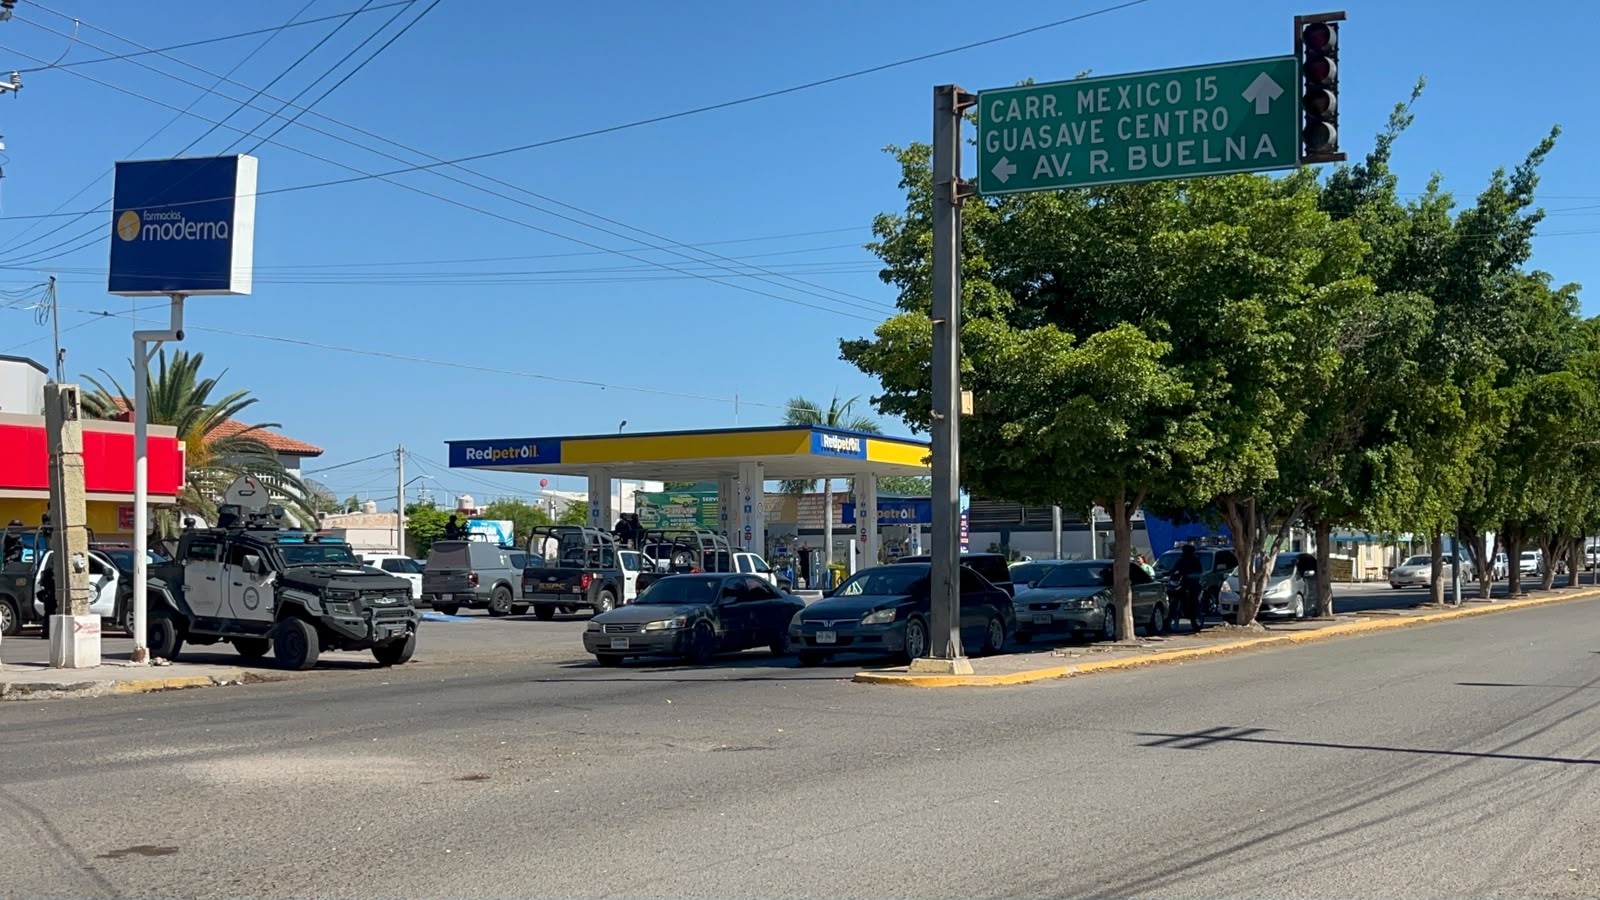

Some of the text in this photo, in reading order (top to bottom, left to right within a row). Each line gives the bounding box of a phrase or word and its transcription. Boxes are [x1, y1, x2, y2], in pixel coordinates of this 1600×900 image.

[990, 76, 1218, 123] CARR. MEXICO 15
[986, 107, 1229, 153] GUASAVE CENTRO
[1032, 133, 1277, 180] AV. R. BUELNA
[142, 217, 228, 241] moderna
[143, 210, 181, 221] farmacias
[466, 445, 537, 461] Redpetroil
